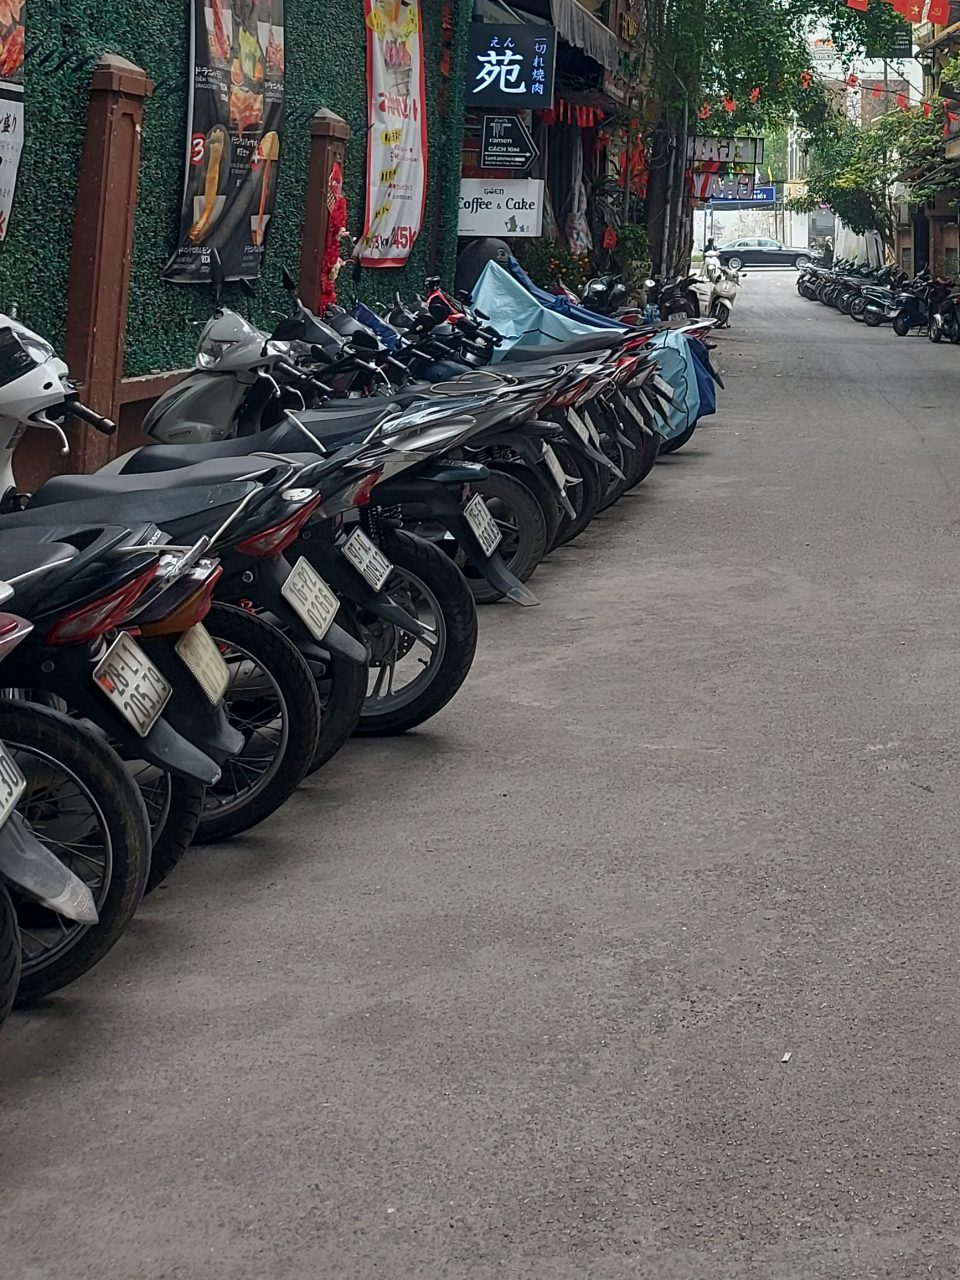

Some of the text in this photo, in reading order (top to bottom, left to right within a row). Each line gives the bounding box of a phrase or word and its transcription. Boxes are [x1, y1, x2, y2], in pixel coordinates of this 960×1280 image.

[490, 36, 515, 48] えん
[472, 49, 527, 94] 苑
[192, 138, 205, 162] 3
[458, 197, 493, 214] Coffee
[505, 198, 536, 210] Cake
[288, 566, 317, 607] 16-P2
[306, 587, 335, 630] 0266
[107, 642, 144, 697] 28-L1
[123, 666, 167, 728] 205.79
